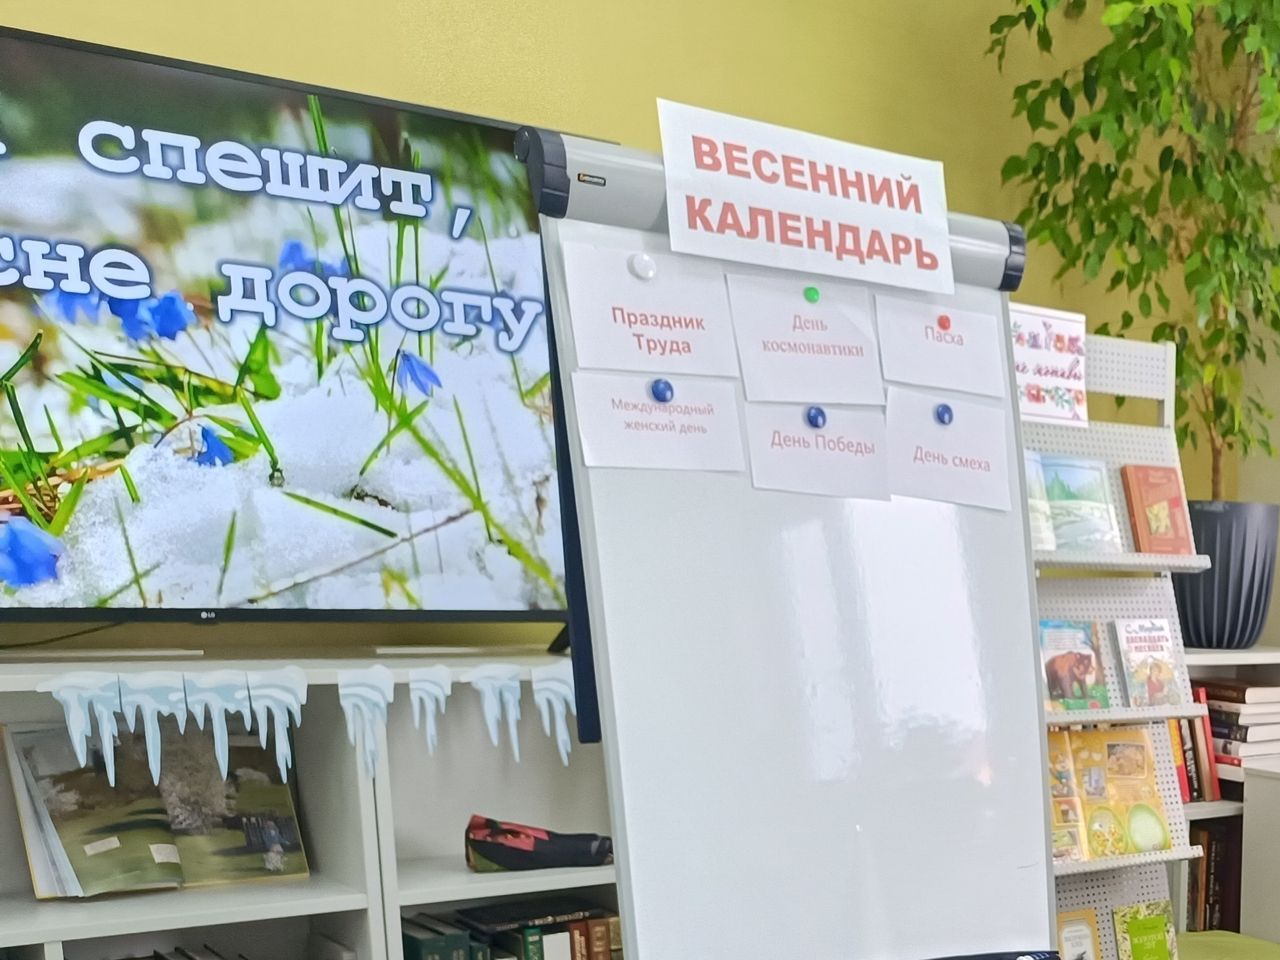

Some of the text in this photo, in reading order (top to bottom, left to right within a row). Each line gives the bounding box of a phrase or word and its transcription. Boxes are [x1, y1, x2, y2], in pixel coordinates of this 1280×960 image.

[691, 135, 923, 215] ВЕСЕННИЙ
[685, 194, 940, 271] КАЛЕНДАРЬ
[217, 263, 543, 352] дорогу
[611, 306, 706, 331] Праздник
[792, 314, 829, 332] День
[632, 333, 692, 356] Труда
[924, 325, 964, 346] Пасха
[762, 339, 864, 358] космонавтики
[611, 397, 714, 416] Международный
[624, 419, 708, 435] женский день
[771, 430, 876, 457] День Победы
[913, 446, 991, 473] День смеха
